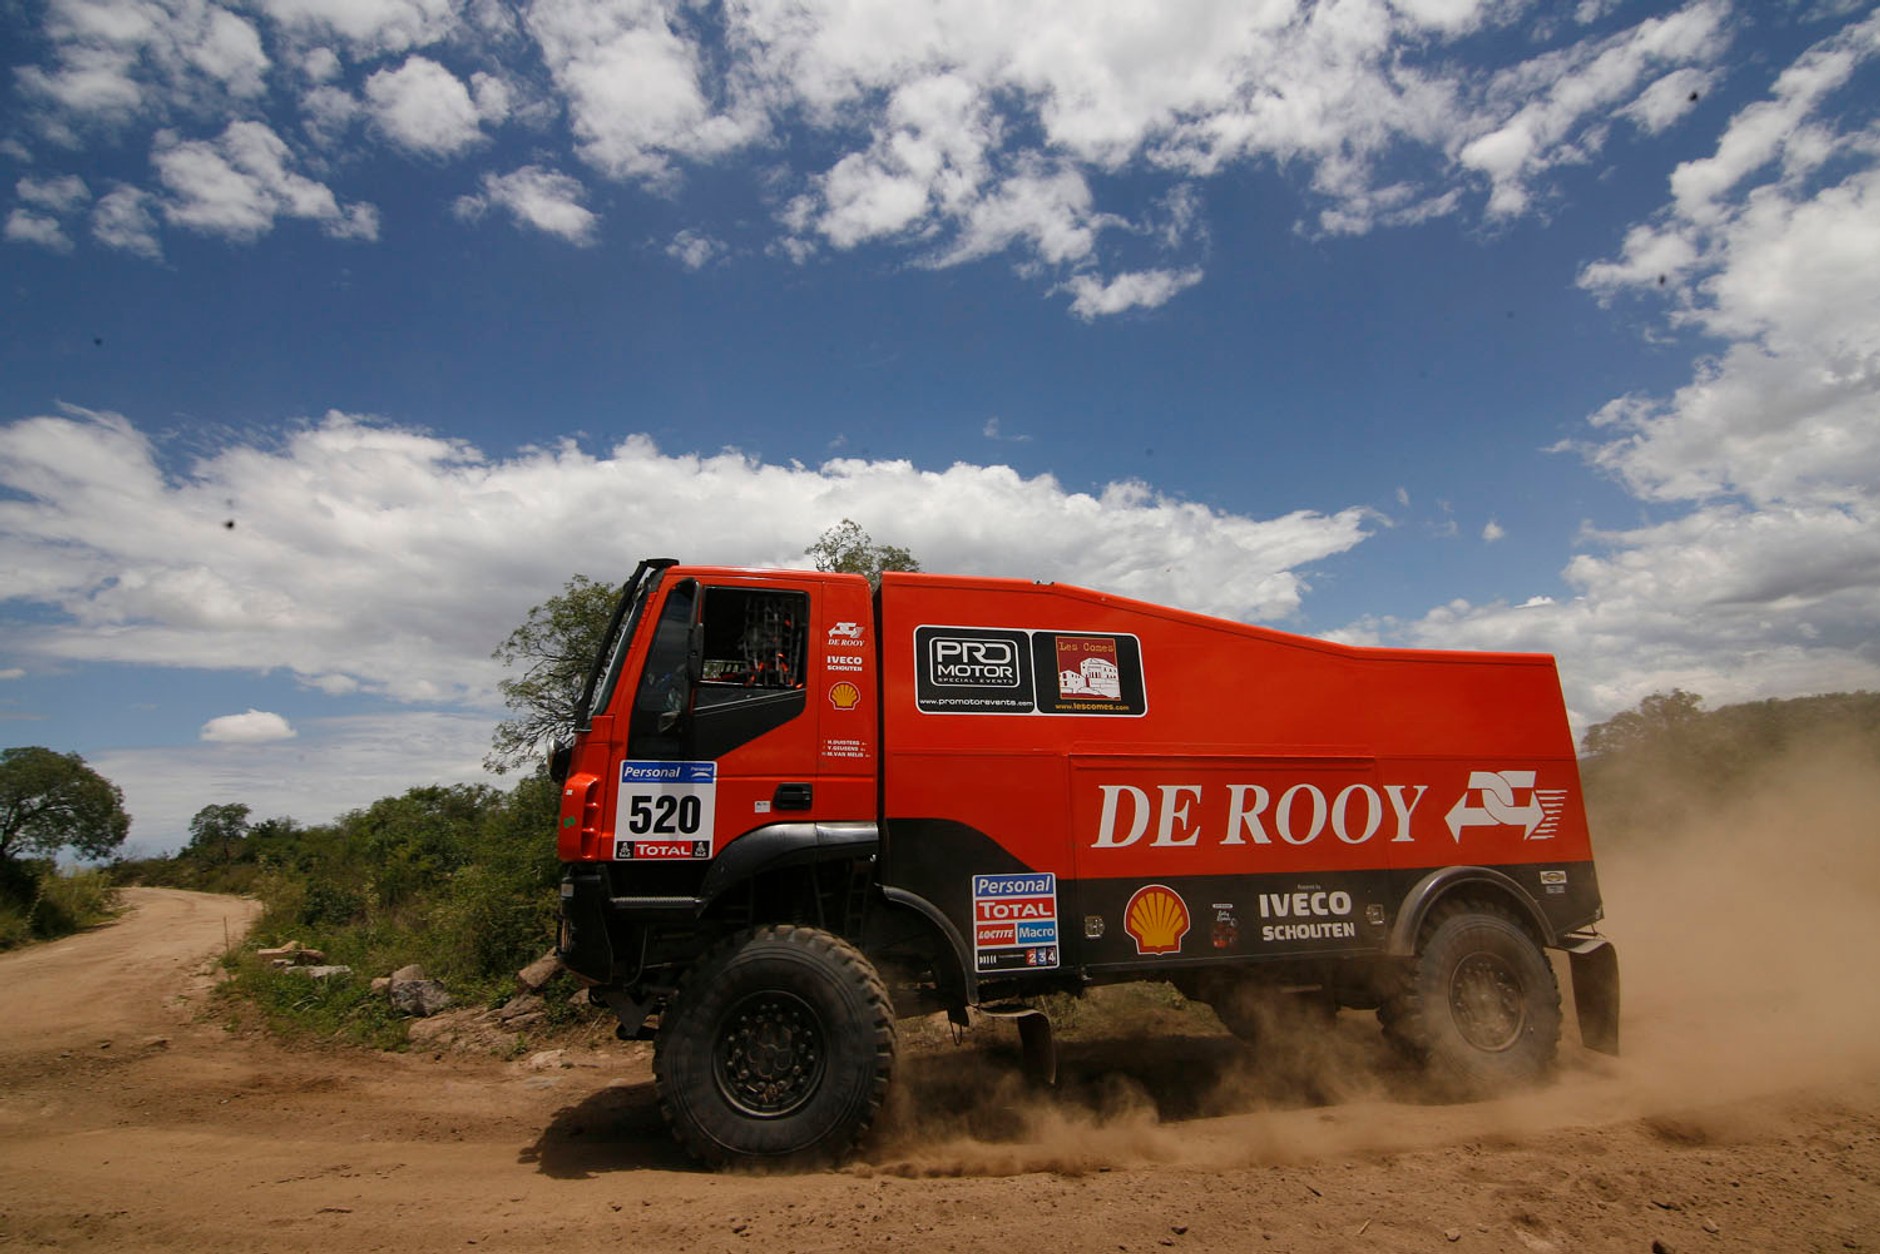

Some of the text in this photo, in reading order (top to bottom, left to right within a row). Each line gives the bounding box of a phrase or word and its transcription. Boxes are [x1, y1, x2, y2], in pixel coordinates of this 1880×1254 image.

[936, 641, 1012, 664] PRO
[1059, 641, 1079, 652] Les
[827, 655, 863, 665] IVECO
[937, 664, 1013, 678] MOTOR
[919, 698, 1034, 707] www.promotorevents.com
[1055, 702, 1130, 711] www.lescomes.com
[624, 766, 681, 778] Personal
[629, 795, 702, 834] 520
[1090, 783, 1429, 848] DE ROOY
[978, 875, 1051, 894] Personal
[1259, 891, 1352, 918] IVECO
[978, 929, 1014, 940] LOCTITE
[1019, 927, 1055, 939] Macro
[1262, 922, 1355, 941] SCHOUTEN
[1028, 952, 1056, 964] 2 3 4
